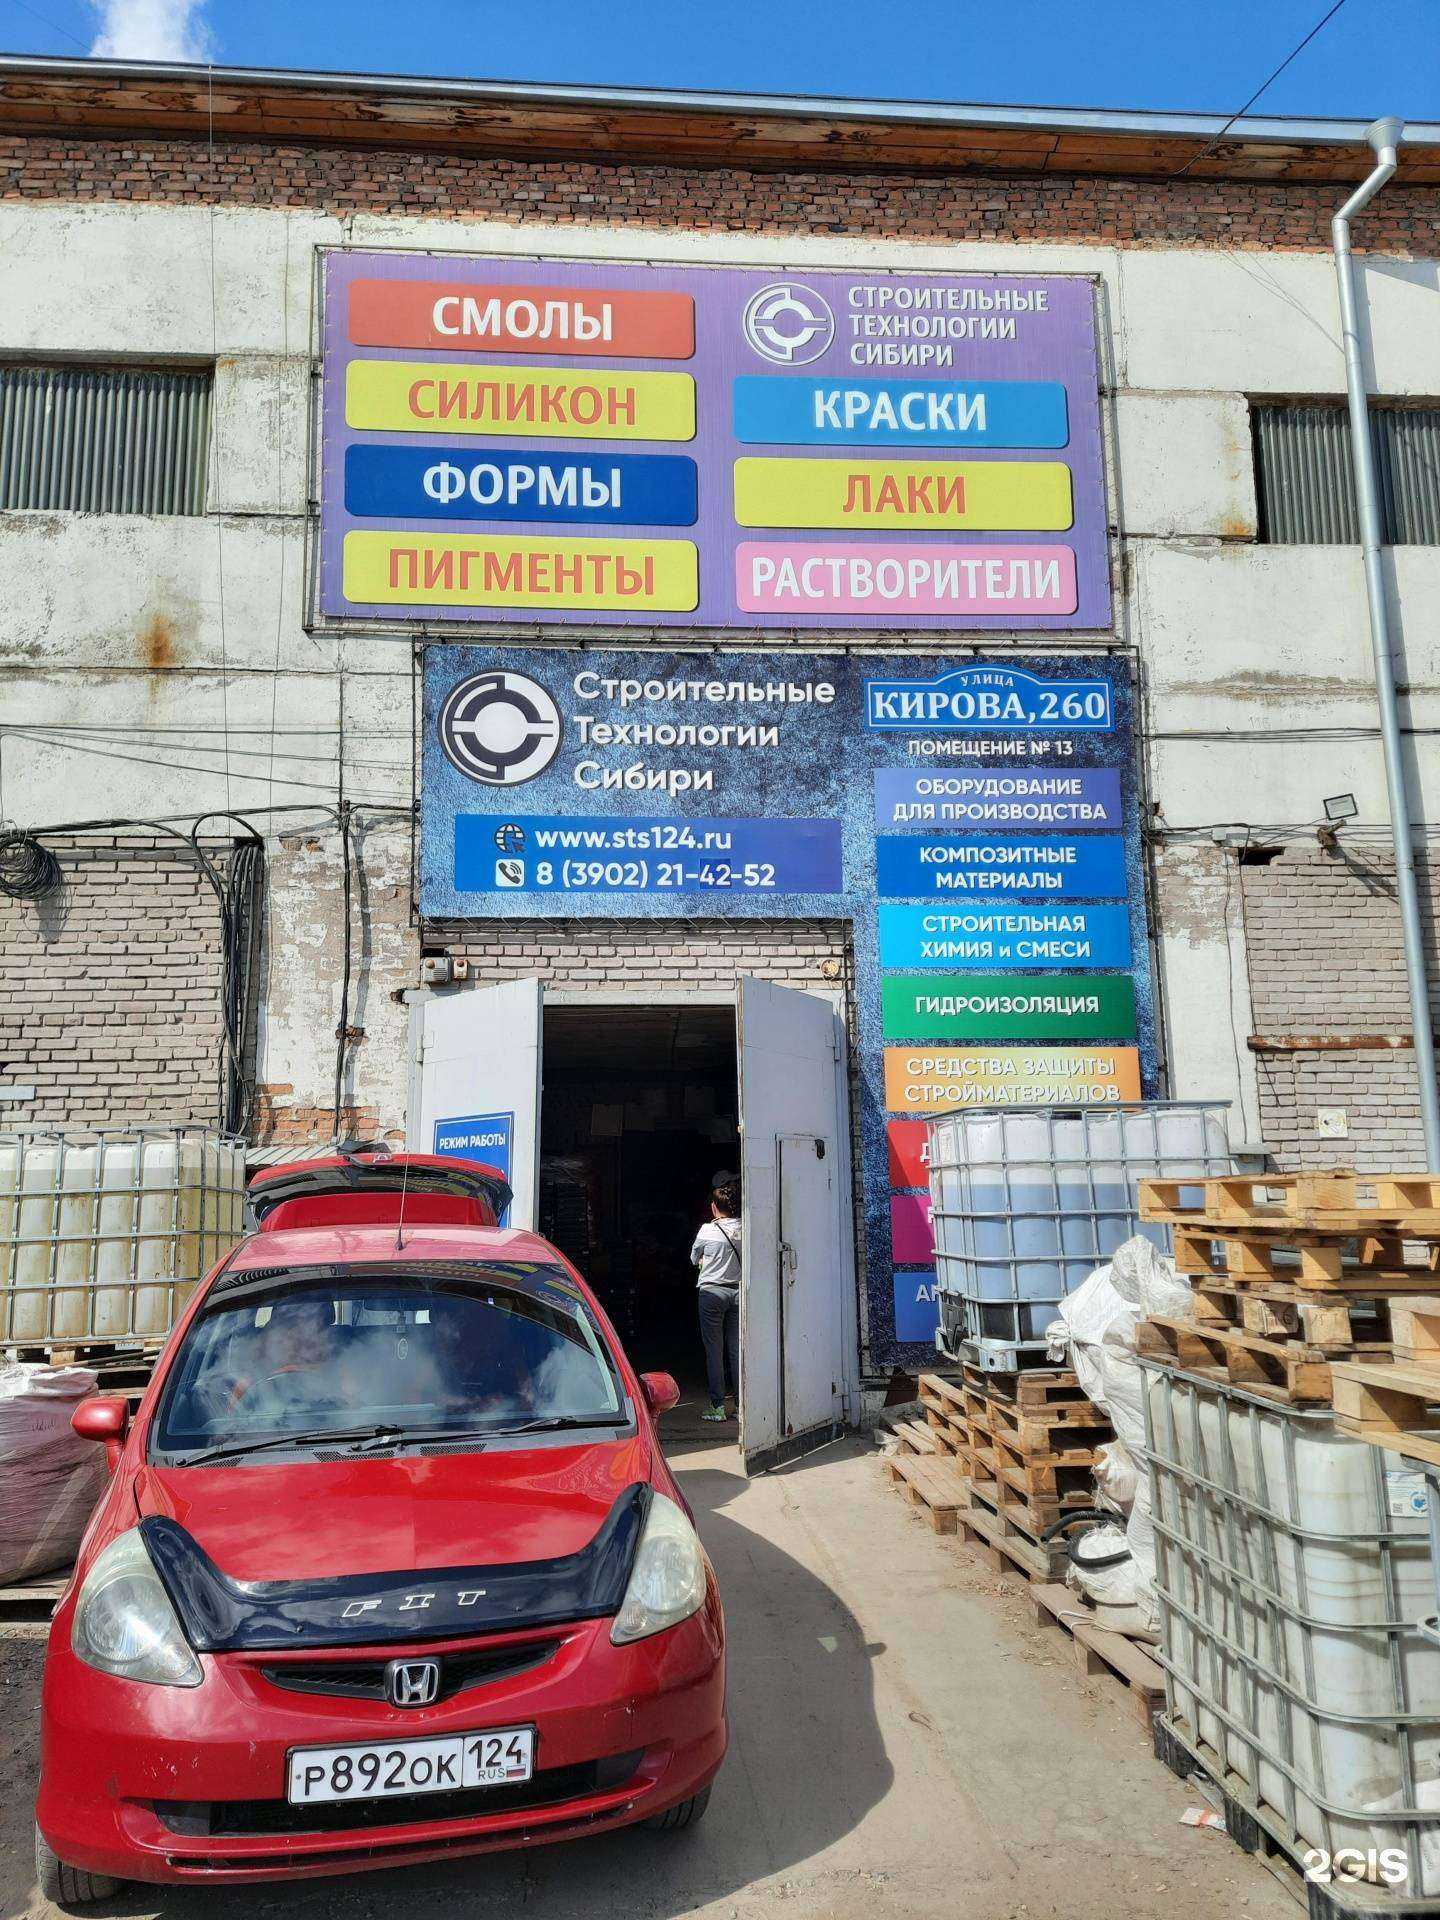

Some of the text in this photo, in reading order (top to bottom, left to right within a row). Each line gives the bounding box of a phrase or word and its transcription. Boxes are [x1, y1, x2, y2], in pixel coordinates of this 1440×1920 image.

[849, 286, 1049, 312] СТРОИТЕЛЬНЫЕ
[432, 296, 612, 341] СМОЛЫ
[849, 315, 1017, 340] ТЕХНОЛОГИИ
[850, 343, 954, 367] СИБИРИ
[408, 380, 636, 426] СИЛИКОН
[814, 390, 987, 431] КРАСКИ
[423, 461, 621, 508] ФОРМЫ
[842, 474, 966, 514] ЛАКИ
[389, 548, 654, 596] ПИГМЕНТЫ
[752, 557, 1061, 599] РАСТВОРИТЕЛИ
[573, 672, 835, 707] Строительные
[961, 674, 1014, 687] УЛИЦА
[574, 716, 780, 747] Технологии
[908, 740, 1073, 757] ПОМЕЩЕНИЕ № 13
[573, 760, 714, 796] Сибири
[916, 779, 1082, 797] ОБОРУДОВАНИЕ
[894, 804, 1107, 822] ДЛЯ ПРОИЗВОДСТВА
[536, 827, 731, 850] www.sts124.ru
[920, 847, 1077, 864] КОМПОЗИТНЫЕ
[536, 861, 775, 888] 8 (3902) 21-42-52
[936, 872, 1063, 889] МАТЕРИАЛЫ
[923, 916, 1086, 932] СТРОИТЕЛЬНАЯ
[920, 942, 993, 958] ХИМИЯ
[1016, 942, 1091, 958] СМЕСИ
[915, 996, 1099, 1016] ГИДРОИЗОЛЯЦИЯ
[906, 1058, 1115, 1078] СРЕДСТВА ЗАЩИТЫ
[904, 1080, 1120, 1102] СТРОЙМАТЕРИАЛОВ
[439, 1133, 506, 1149] РЕЖИМ РАБОТЫ
[468, 1735, 522, 1769] 124
[478, 1767, 505, 1780] RUS
